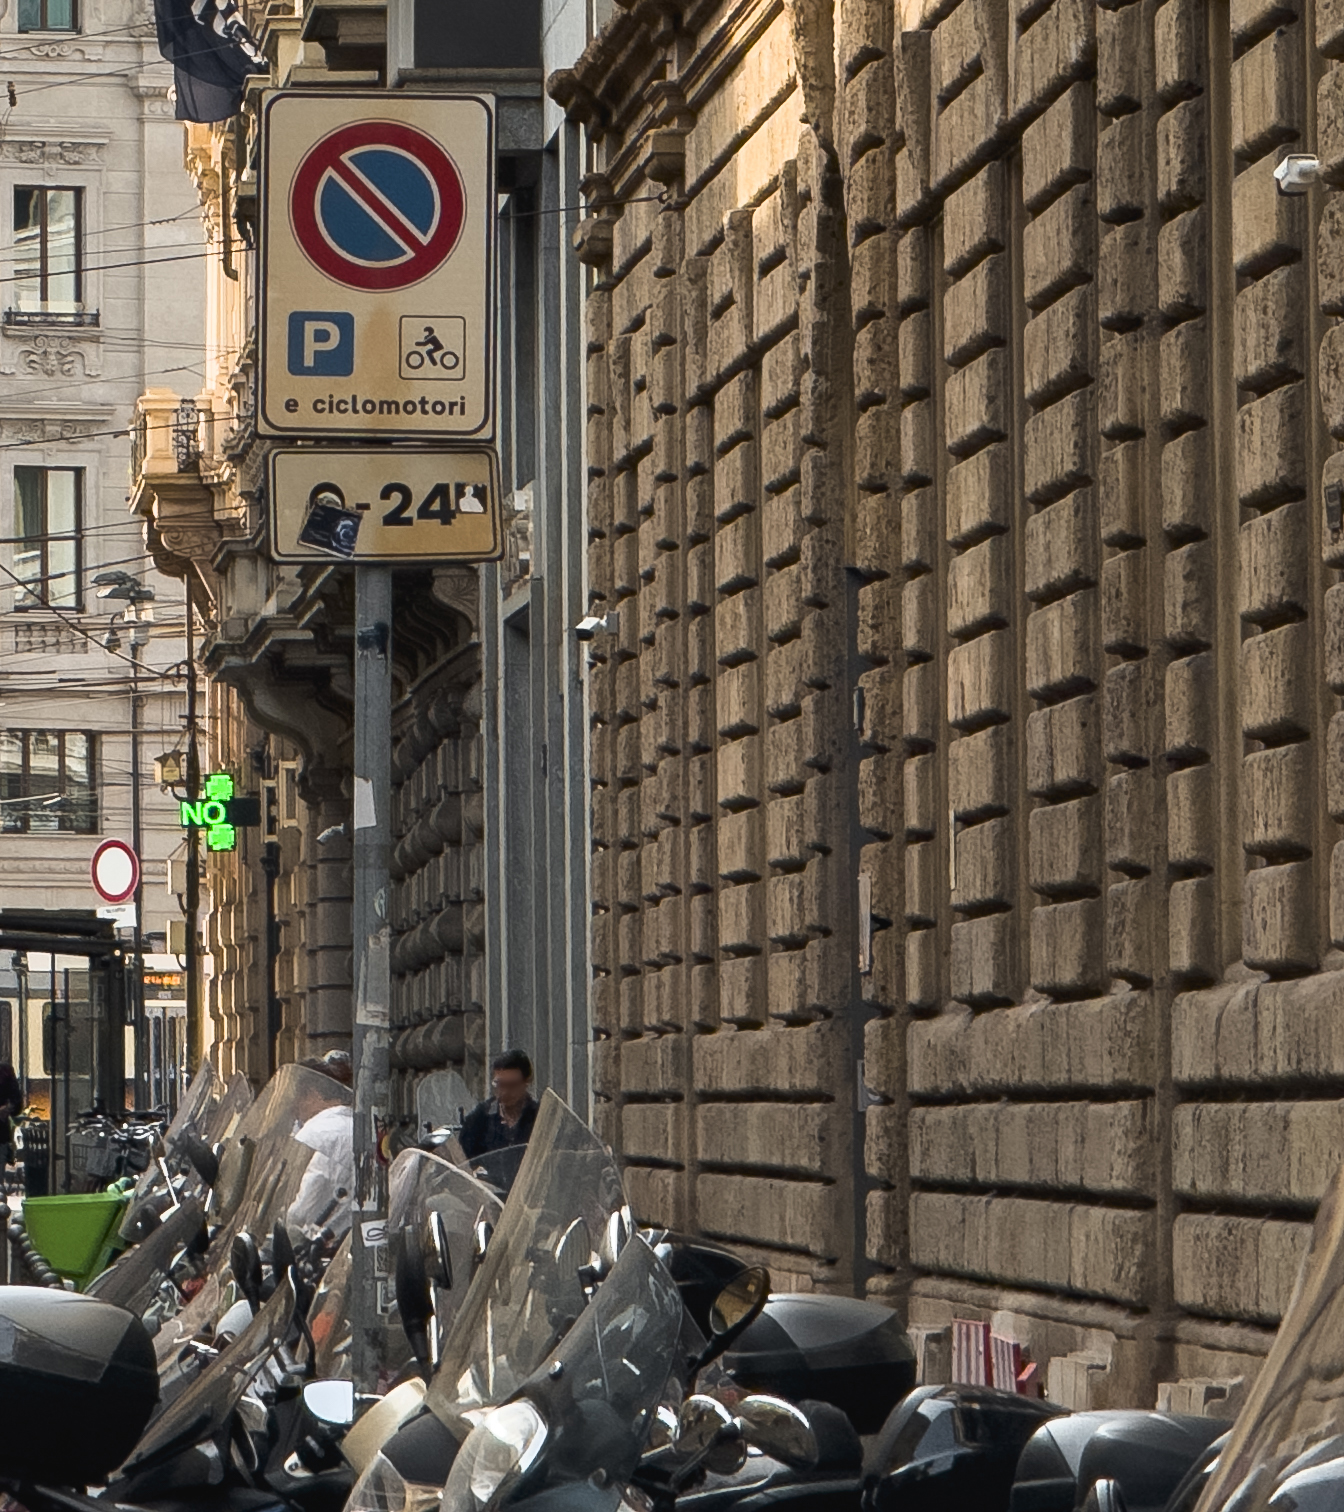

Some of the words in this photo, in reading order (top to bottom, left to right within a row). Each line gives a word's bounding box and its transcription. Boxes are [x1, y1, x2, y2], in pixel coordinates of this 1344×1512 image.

[302, 320, 341, 368] P
[284, 397, 300, 415] e
[312, 394, 467, 416] ciclomotori
[181, 800, 226, 826] NO
